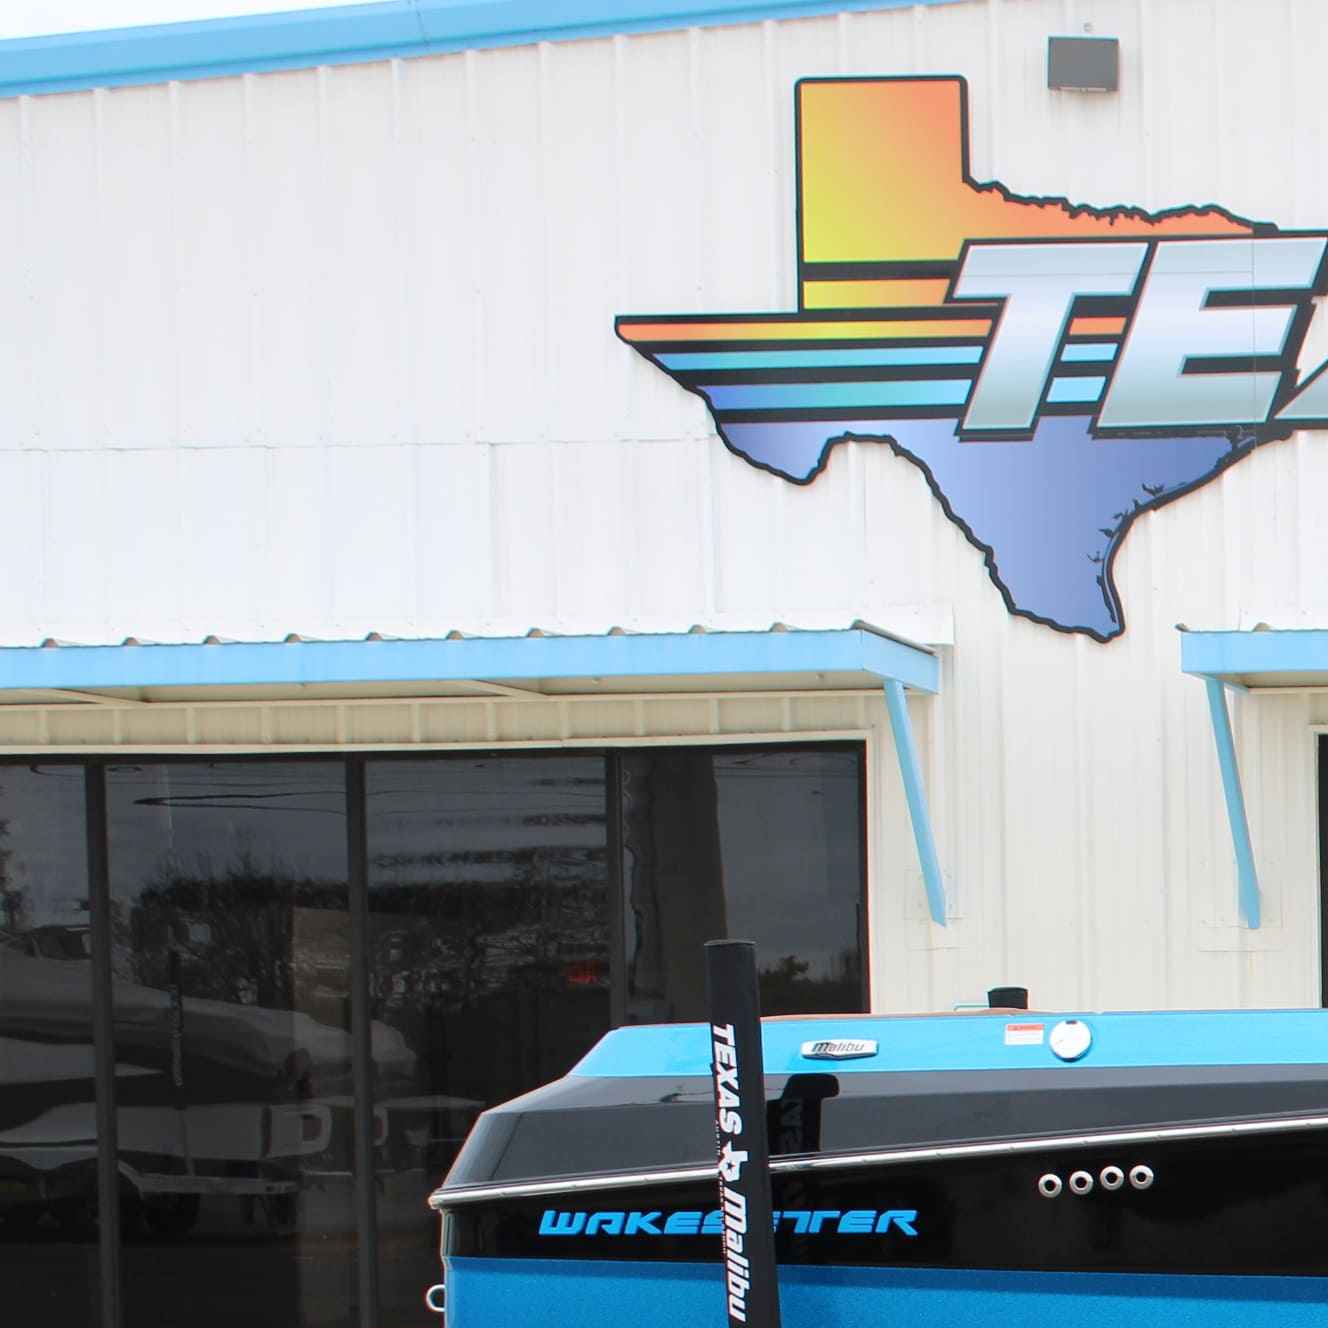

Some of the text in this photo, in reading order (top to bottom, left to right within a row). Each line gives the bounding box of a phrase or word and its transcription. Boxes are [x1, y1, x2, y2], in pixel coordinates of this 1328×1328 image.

[811, 1041, 865, 1053] Malibu
[712, 1023, 752, 1323] TEXAS Malibu
[538, 1209, 919, 1236] WAKESTTER
